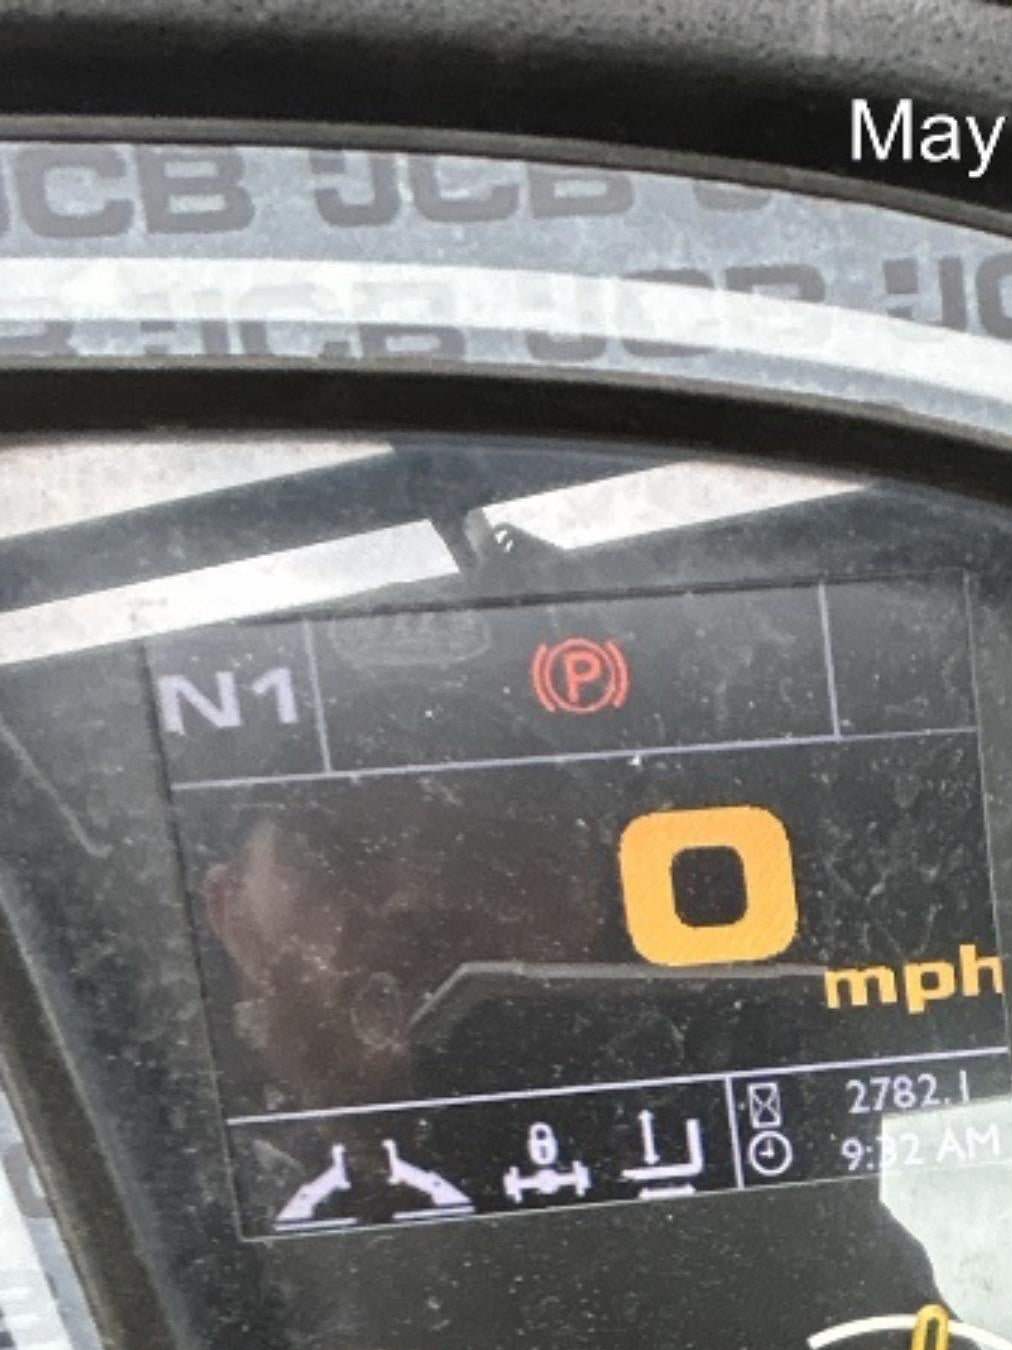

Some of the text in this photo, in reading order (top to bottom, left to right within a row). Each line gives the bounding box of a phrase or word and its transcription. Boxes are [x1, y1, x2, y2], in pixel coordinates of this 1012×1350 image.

[158, 664, 301, 736] N1
[618, 804, 798, 968] 0
[824, 943, 1004, 1014] mph
[935, 1123, 1002, 1164] AM
